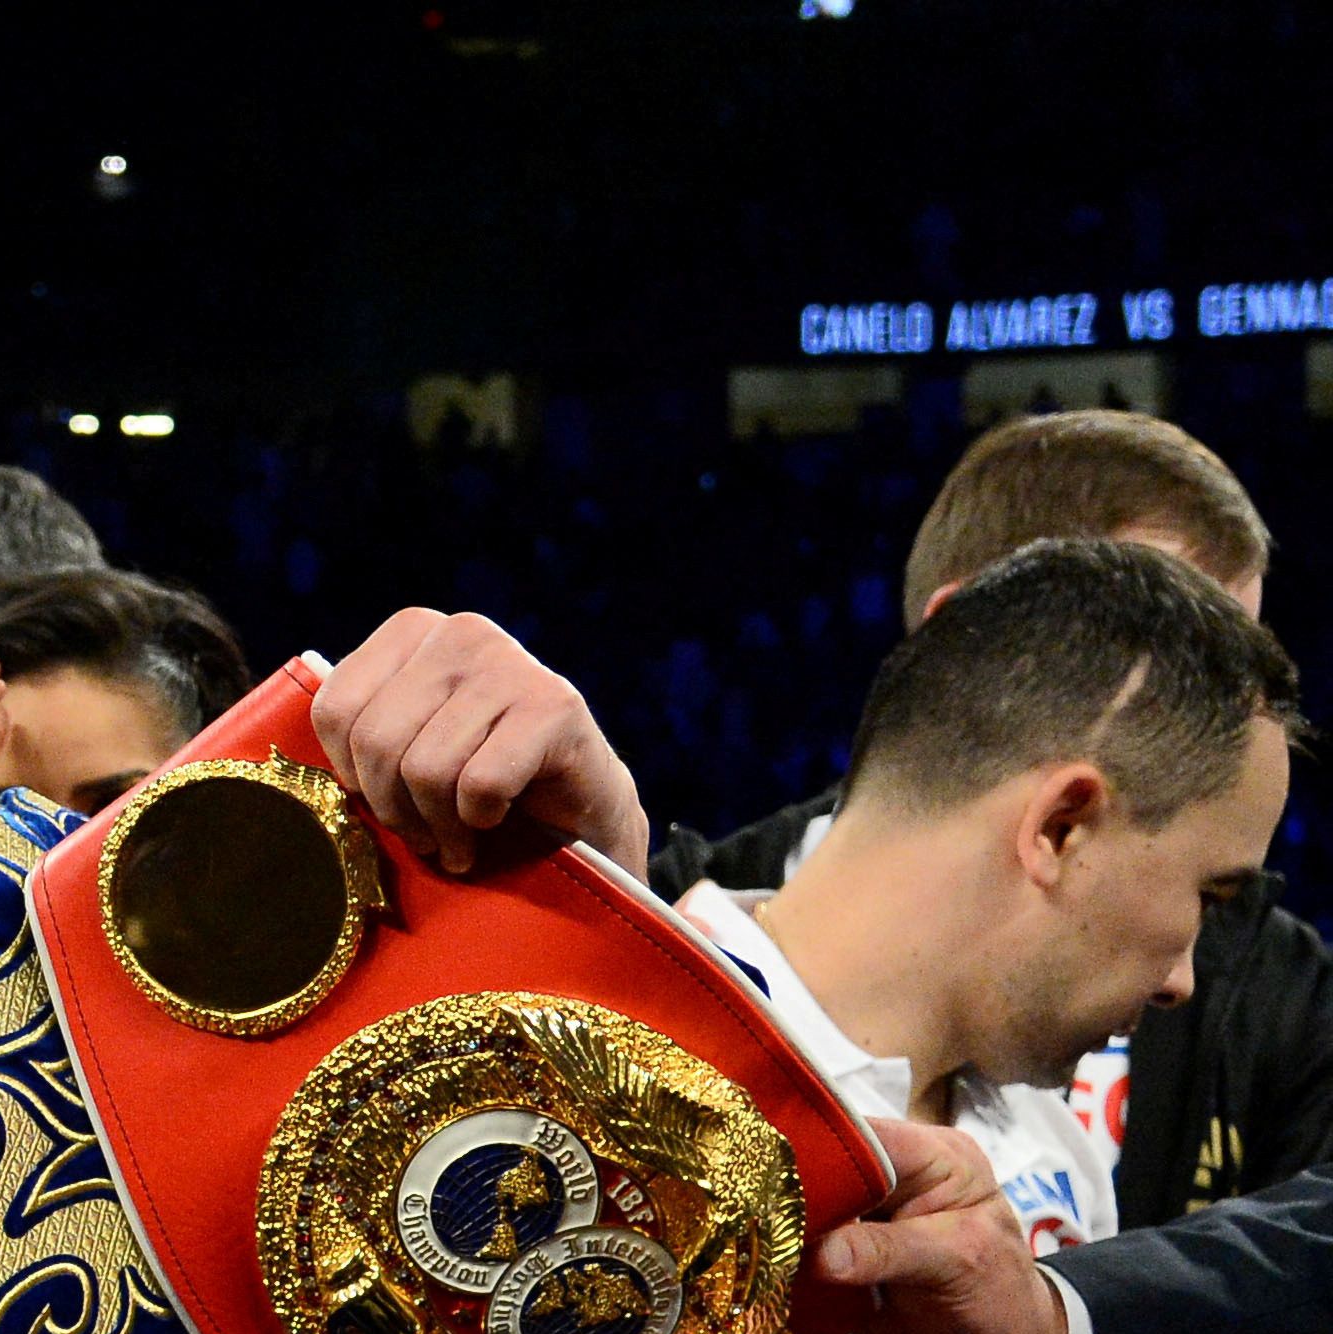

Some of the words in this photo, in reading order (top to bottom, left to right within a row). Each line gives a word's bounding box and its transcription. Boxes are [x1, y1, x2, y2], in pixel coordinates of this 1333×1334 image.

[801, 302, 933, 354] CANELO
[946, 293, 1097, 350] ALVAREZ
[1123, 289, 1173, 339] VS
[534, 1120, 596, 1201] World
[607, 1176, 654, 1224] IBF
[400, 1193, 489, 1286] Champion
